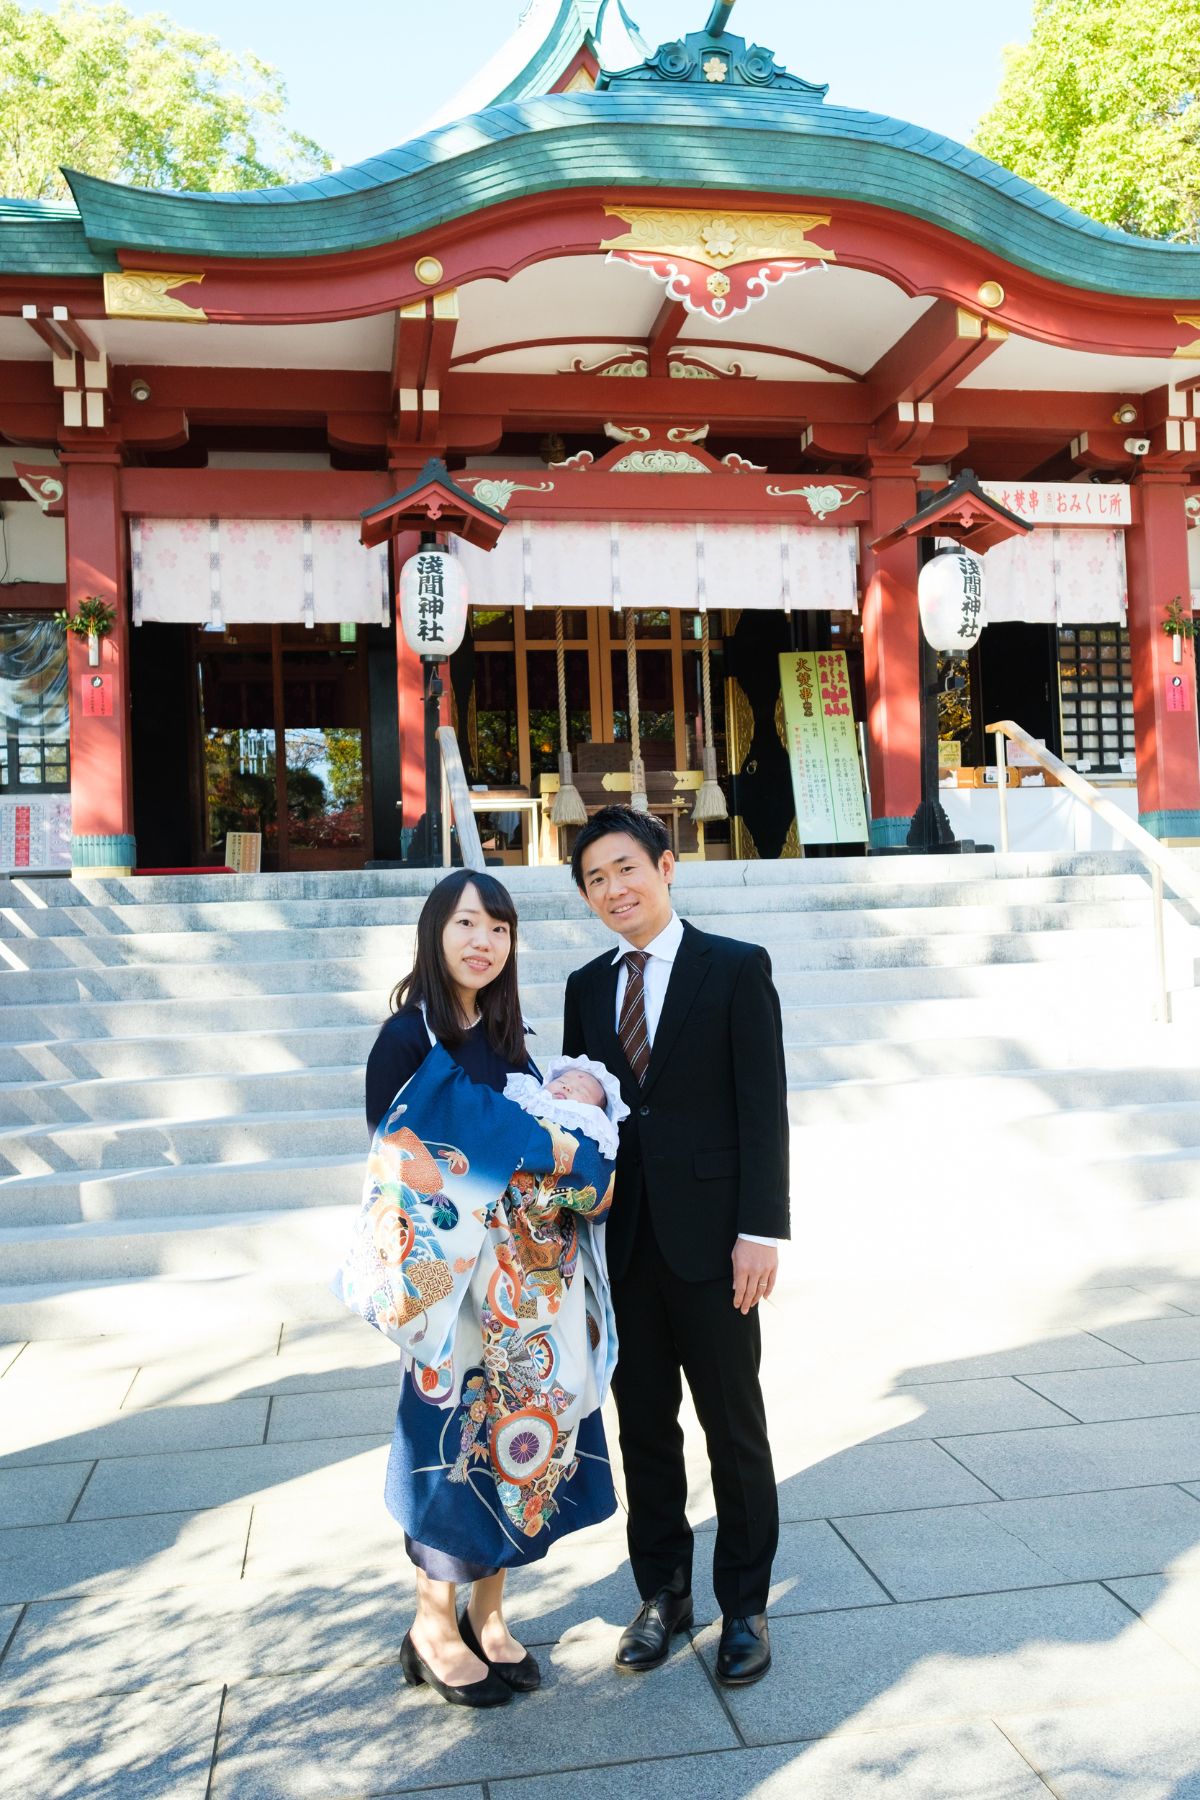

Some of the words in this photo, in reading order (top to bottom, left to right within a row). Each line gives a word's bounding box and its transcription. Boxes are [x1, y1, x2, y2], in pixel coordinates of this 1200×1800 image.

[1057, 492, 1122, 516] おみくじ所
